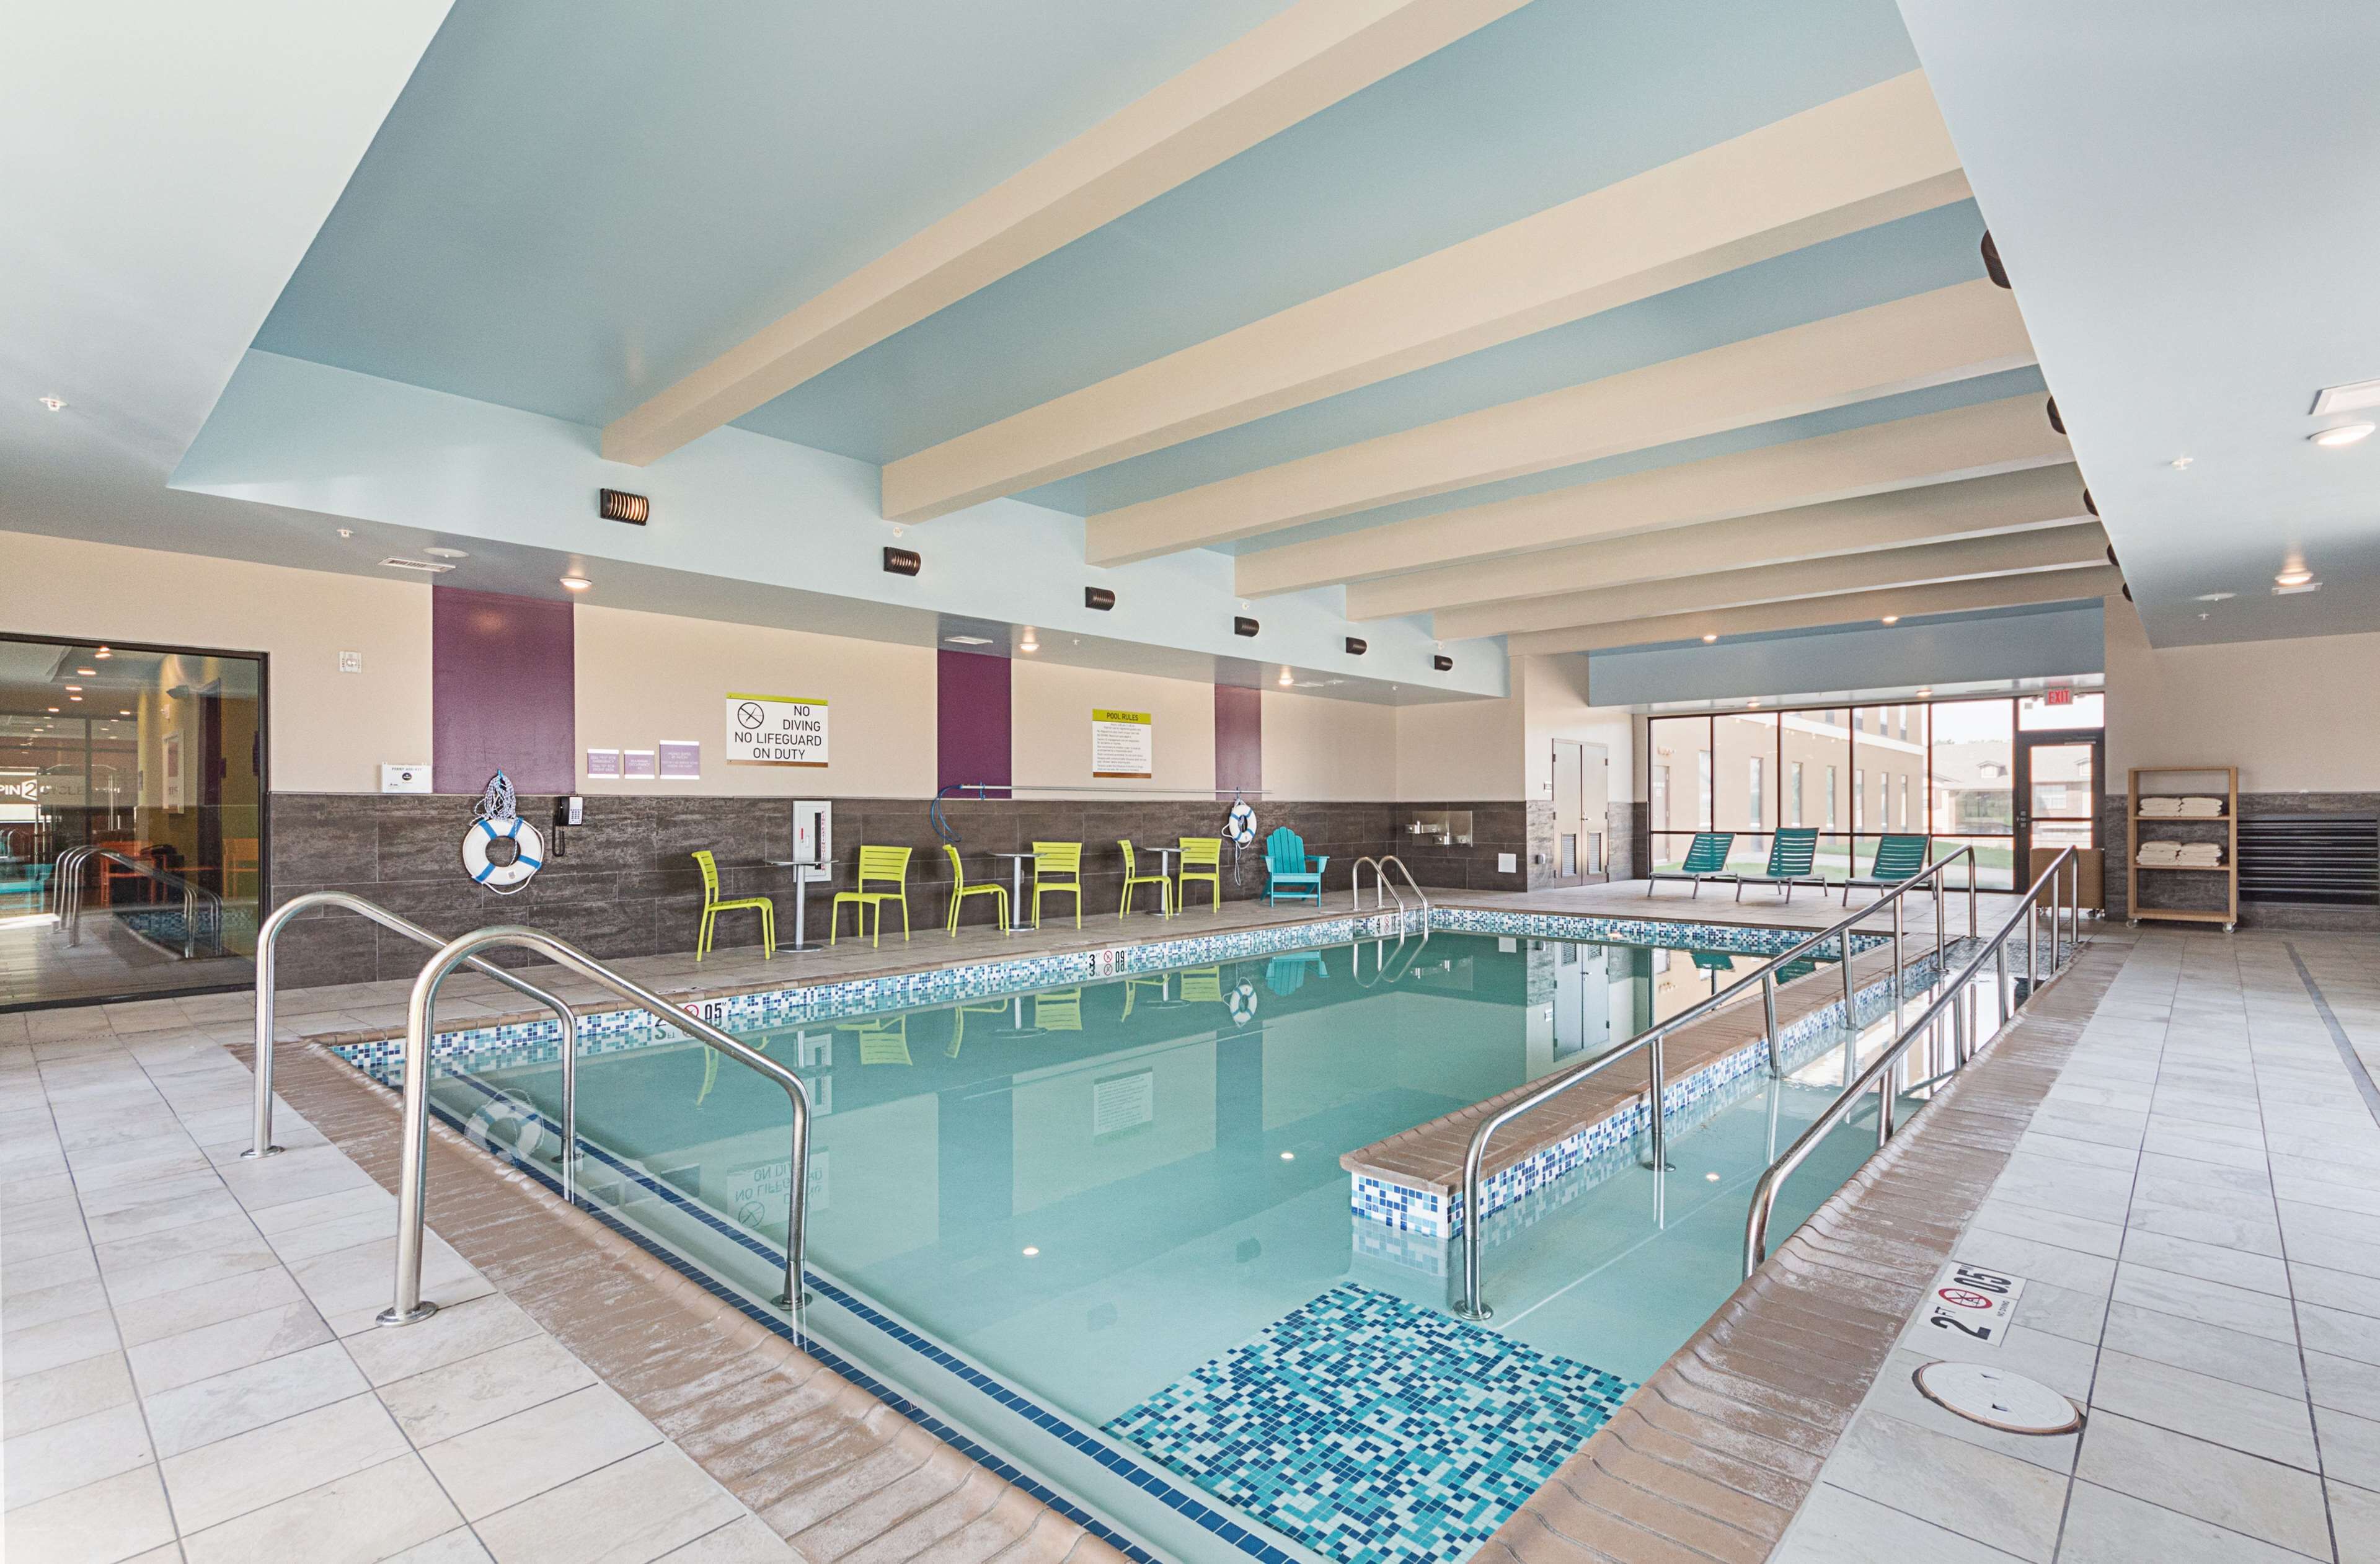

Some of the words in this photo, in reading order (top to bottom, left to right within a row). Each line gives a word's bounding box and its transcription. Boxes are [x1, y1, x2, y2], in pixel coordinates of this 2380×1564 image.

[2048, 689, 2069, 704] EXIT
[794, 705, 810, 717] NO
[783, 719, 821, 732] DIVING
[735, 731, 752, 743] NO
[757, 733, 821, 746] LIFEGUARD
[753, 748, 770, 759] ON
[775, 748, 805, 760] DUTY
[1089, 954, 1095, 966] 3
[1934, 1306, 1956, 1318] FT
[1930, 1316, 1991, 1340] 2
